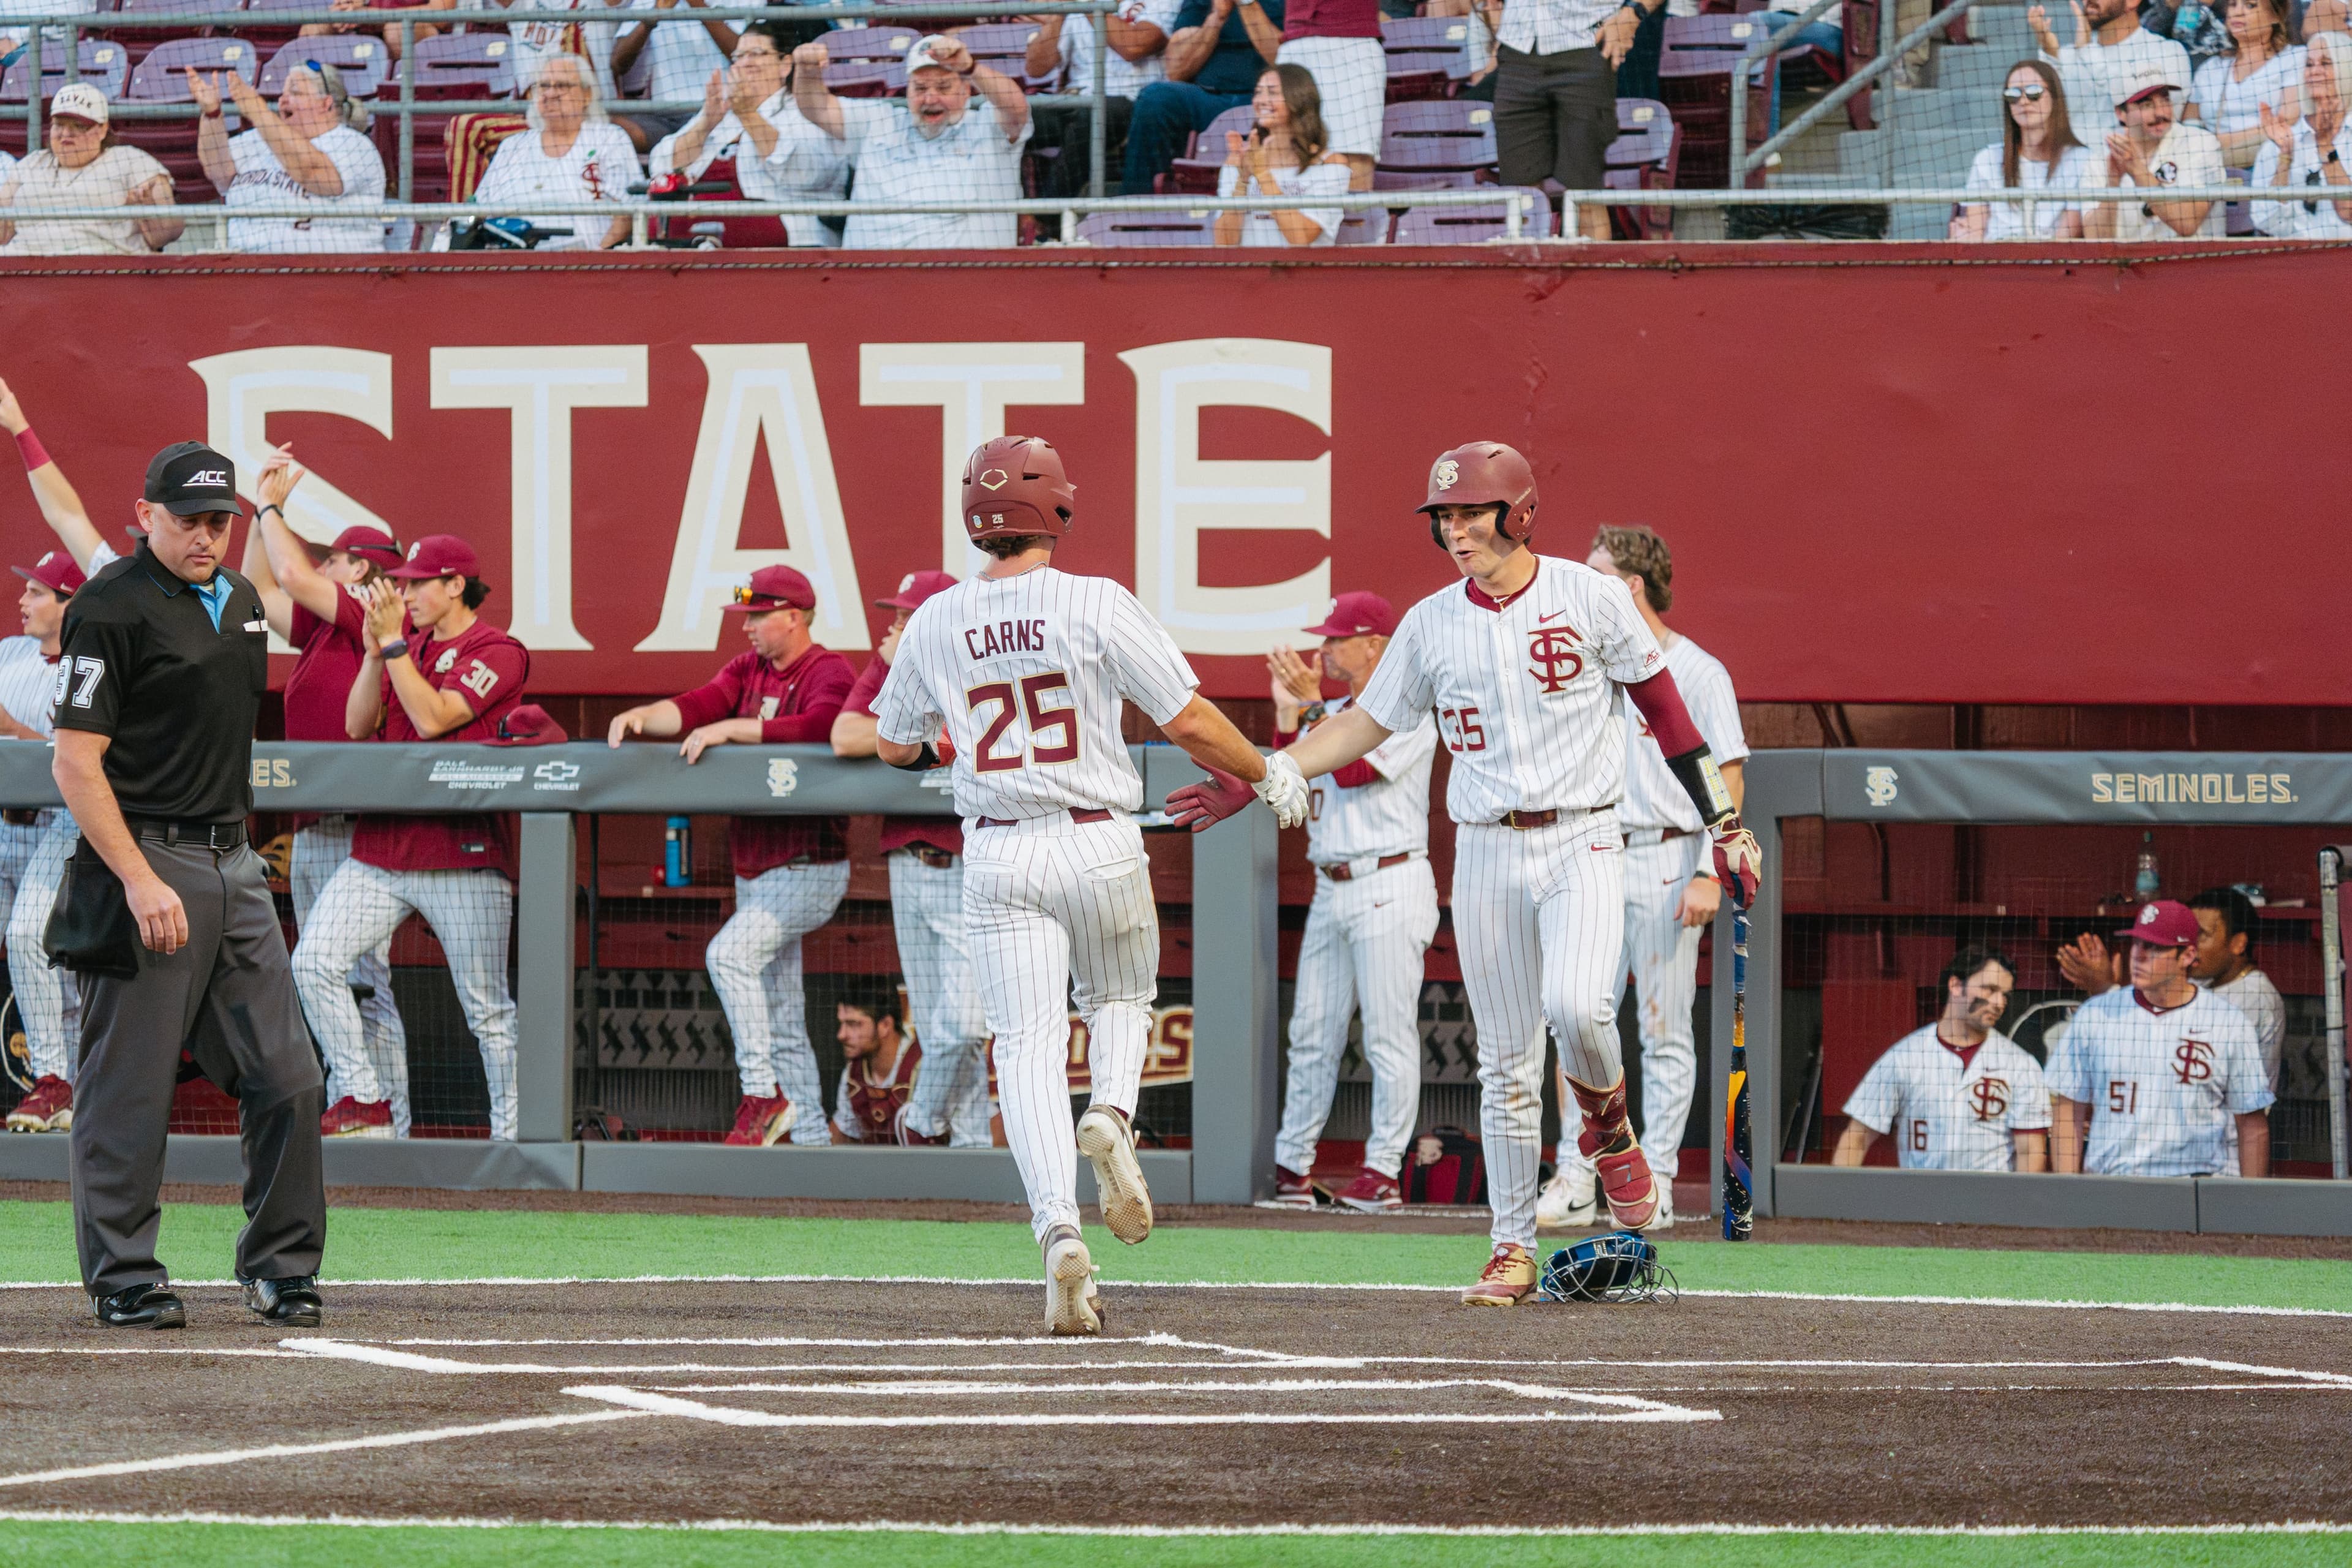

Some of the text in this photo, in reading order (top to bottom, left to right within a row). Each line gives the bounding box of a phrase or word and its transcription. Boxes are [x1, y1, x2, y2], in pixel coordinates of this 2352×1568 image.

[186, 469, 227, 484] ACC
[189, 337, 1333, 657] STATE
[992, 514, 1005, 524] 25
[964, 619, 1046, 660] CARNS
[460, 658, 499, 699] 30
[964, 669, 1082, 775] 25
[1442, 707, 1487, 752] 35
[2109, 1081, 2138, 1114] 51
